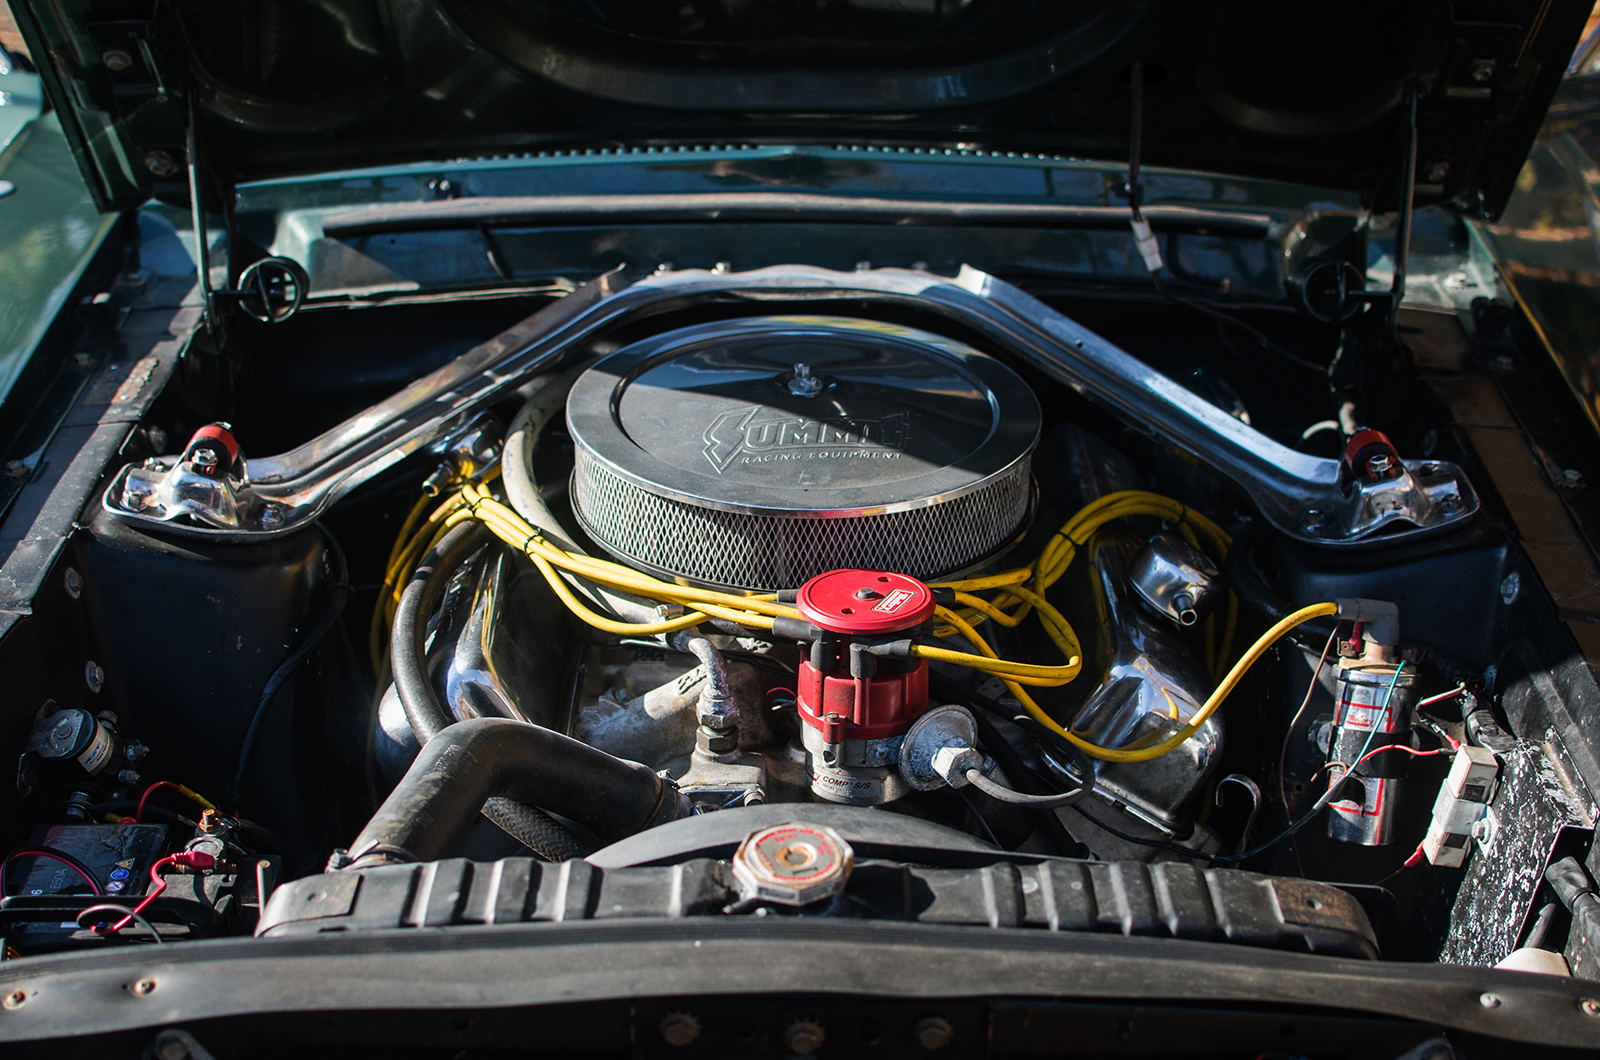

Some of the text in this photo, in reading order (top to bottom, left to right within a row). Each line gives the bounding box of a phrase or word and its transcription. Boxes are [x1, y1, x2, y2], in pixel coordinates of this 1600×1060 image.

[702, 405, 911, 474] SUMMIT
[741, 451, 902, 464] RACING EQUIPMENT
[822, 775, 849, 787] COMP
